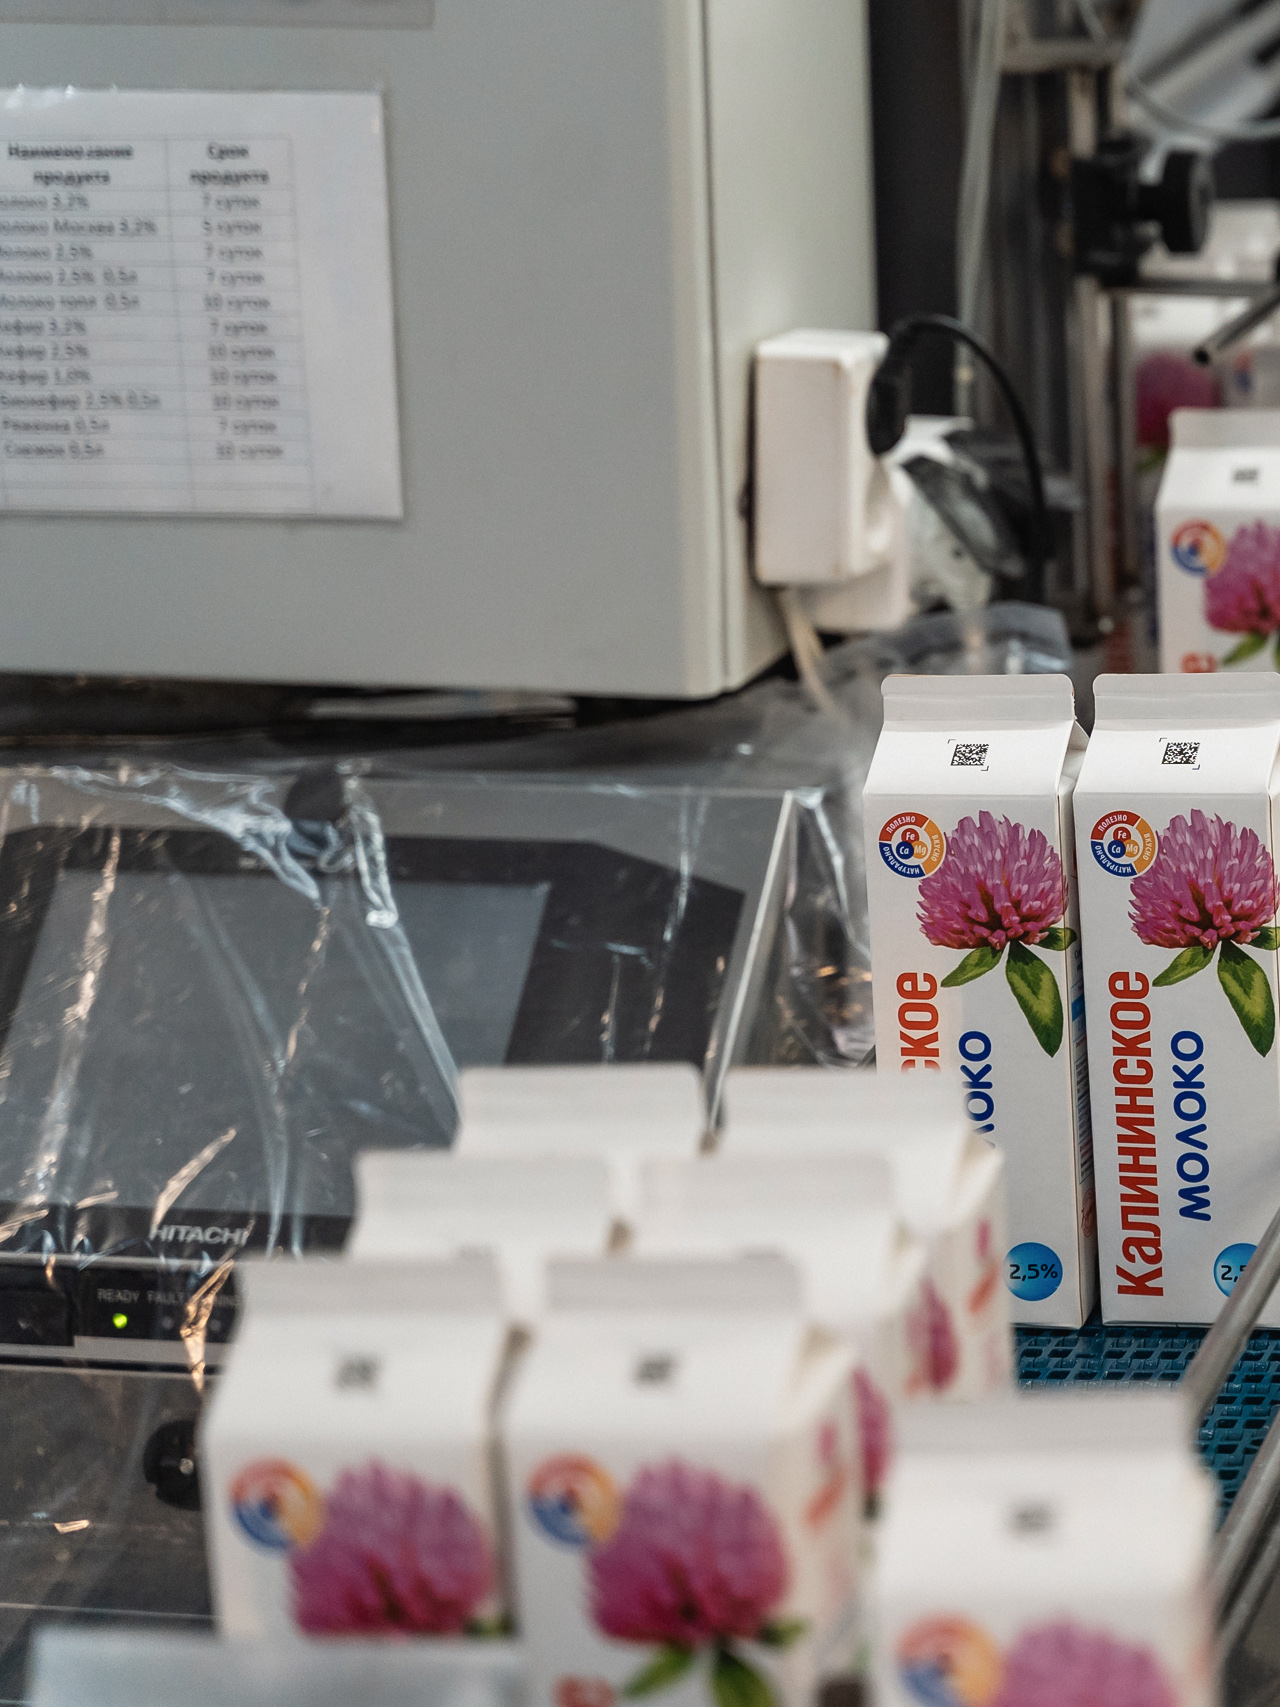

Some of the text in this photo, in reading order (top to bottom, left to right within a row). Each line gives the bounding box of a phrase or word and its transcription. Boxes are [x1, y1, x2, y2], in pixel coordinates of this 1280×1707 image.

[885, 815, 916, 834] ПОЛЕЗНО
[1097, 814, 1128, 833] ПОЛЕЗНО
[906, 831, 915, 841] Fe
[1117, 830, 1127, 840] Fe
[899, 846, 910, 855] Ca
[914, 845, 927, 856] Mg
[931, 834, 941, 862] ВКУСНО
[1111, 845, 1121, 854] Ca
[1126, 843, 1139, 855] Mg
[1142, 832, 1153, 861] ВКУСНО
[882, 846, 920, 875] НАТУРАЛЬНО
[1094, 845, 1132, 874] НАТУРАЛЬНО
[1107, 971, 1164, 1297] Калининское
[151, 1224, 249, 1246] HITACHI
[1009, 1263, 1059, 1282] 2,5%
[1220, 1264, 1248, 1283] 2,
